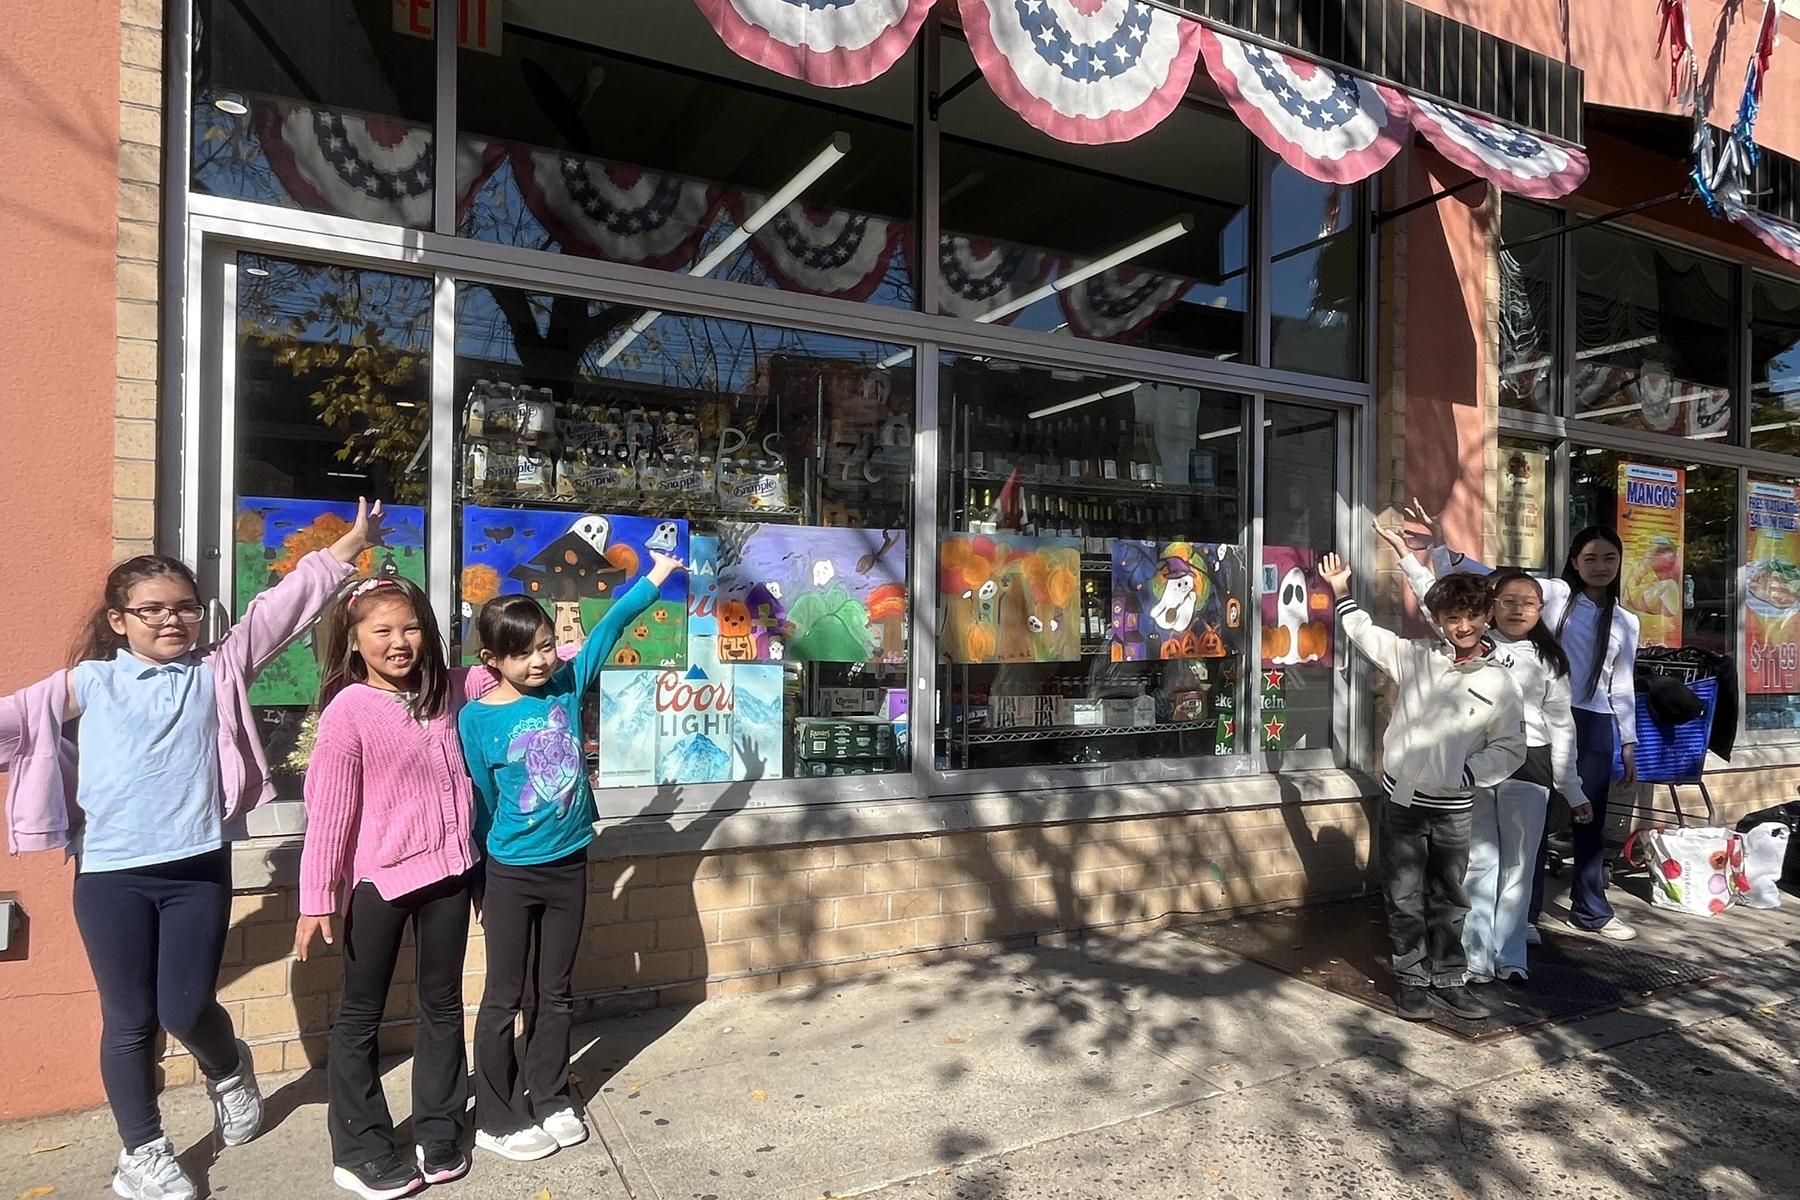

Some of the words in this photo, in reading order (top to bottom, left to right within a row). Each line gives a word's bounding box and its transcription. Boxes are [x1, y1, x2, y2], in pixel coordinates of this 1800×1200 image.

[483, 461, 536, 479] Snapple
[658, 470, 702, 490] Snapple
[733, 475, 776, 496] Snapple
[1626, 481, 1677, 509] MANGOS
[1034, 696, 1054, 711] IPA
[660, 713, 732, 737] LIGHT
[1034, 711, 1054, 727] IPA
